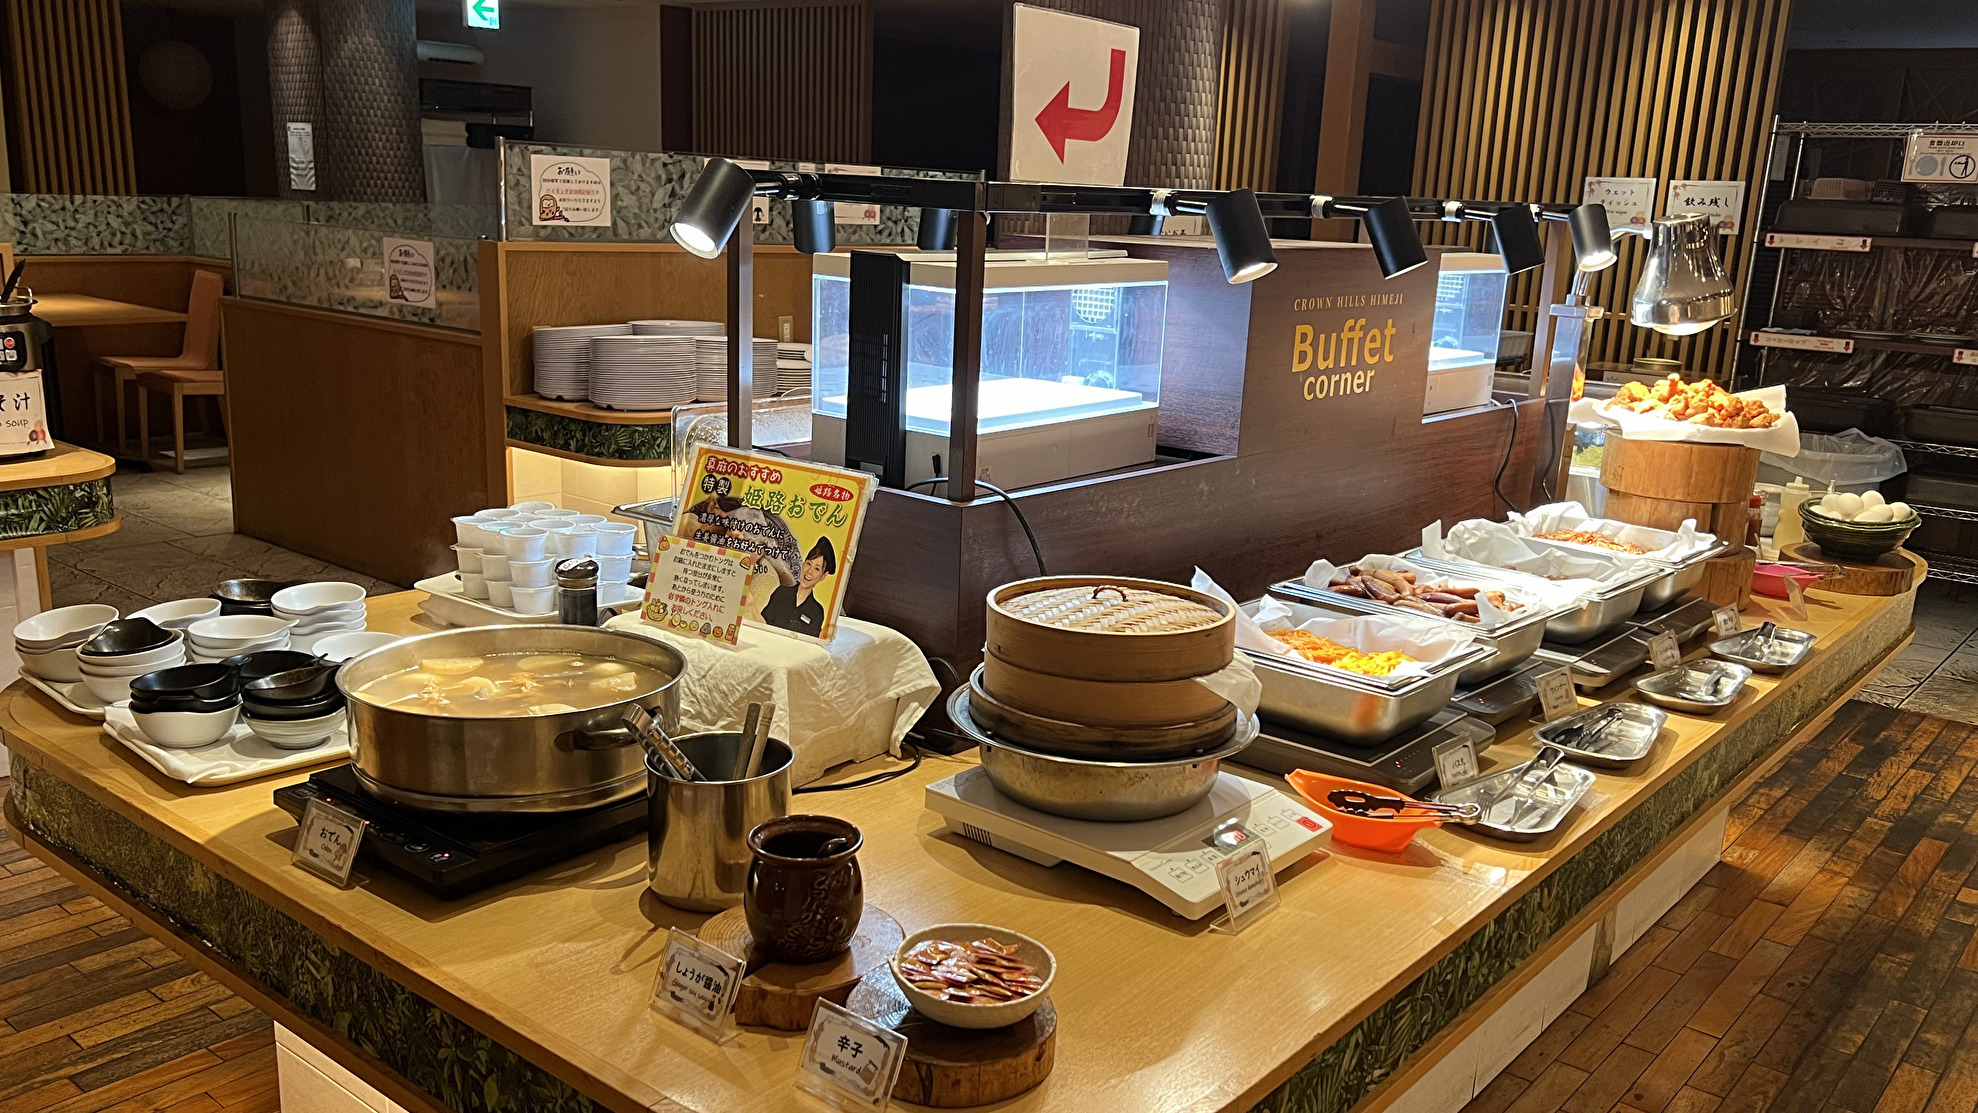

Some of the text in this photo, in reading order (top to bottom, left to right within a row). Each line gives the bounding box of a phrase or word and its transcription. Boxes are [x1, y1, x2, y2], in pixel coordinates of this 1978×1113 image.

[1604, 188, 1635, 196] ウェット
[1683, 196, 1729, 208] 飲み残し
[1294, 293, 1404, 311] CROWN HILLS HIMEJI
[1291, 317, 1397, 373] Buffet
[1303, 368, 1376, 401] corner
[703, 476, 731, 496] 特製
[814, 486, 852, 501] 姫路名物
[742, 485, 848, 527] 姫路おでん
[698, 512, 786, 540] 濃厚な味付けのおでんに
[320, 827, 341, 846] おでん
[1234, 863, 1260, 886] シュウマイ
[676, 961, 722, 995] しょうが醤油
[837, 1034, 864, 1059] 辛子
[831, 1053, 863, 1075] Mustard
